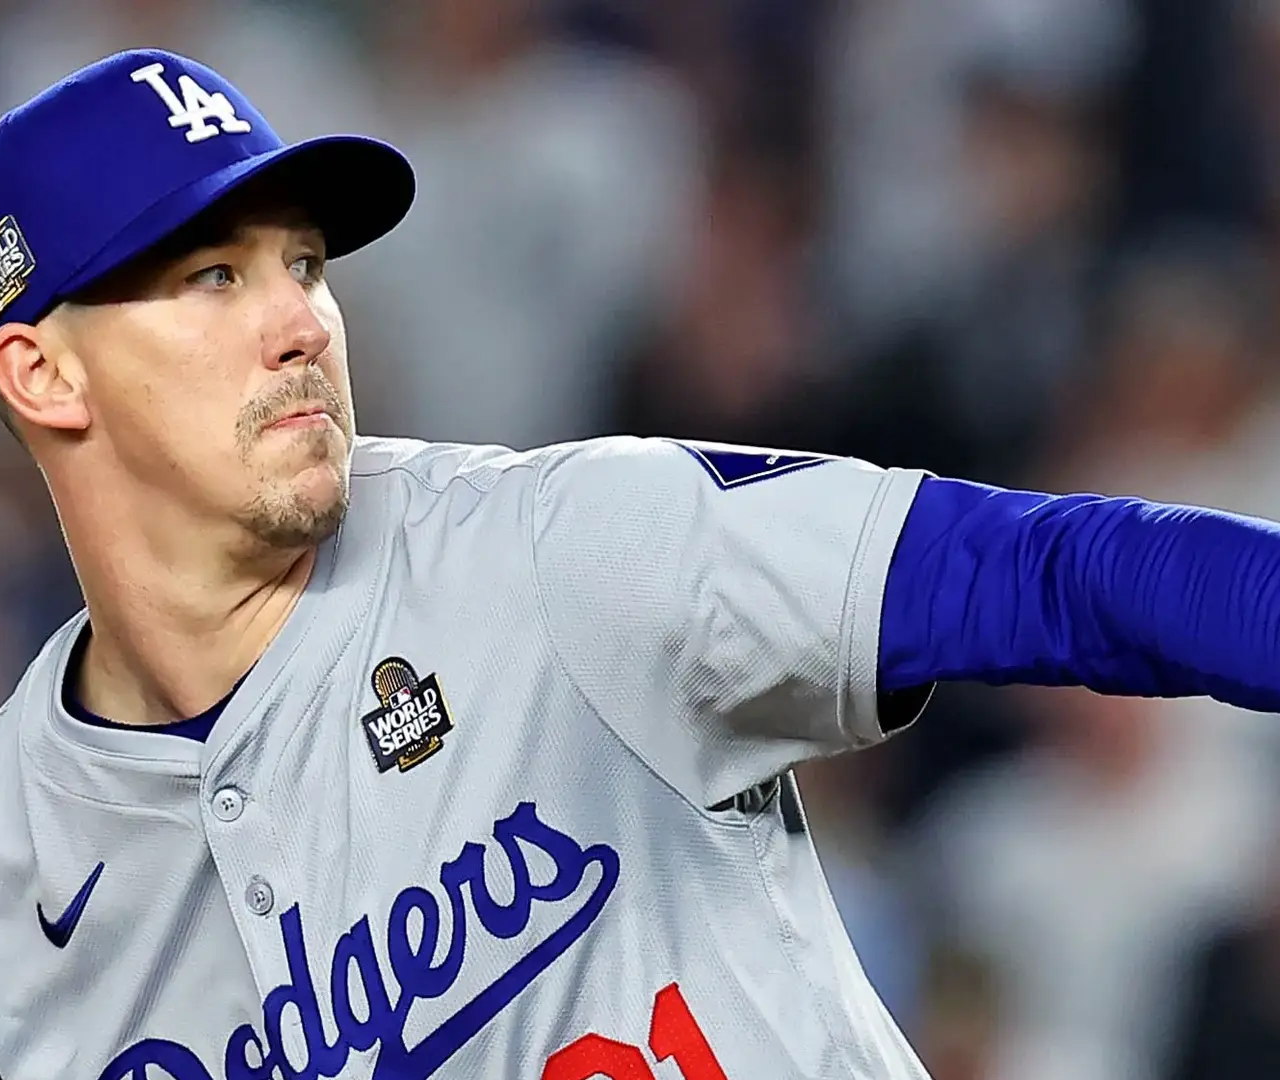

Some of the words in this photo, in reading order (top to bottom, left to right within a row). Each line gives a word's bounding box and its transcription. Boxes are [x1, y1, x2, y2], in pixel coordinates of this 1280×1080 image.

[130, 63, 252, 143] LA
[368, 688, 437, 739] WORLD
[378, 705, 442, 756] SERIES
